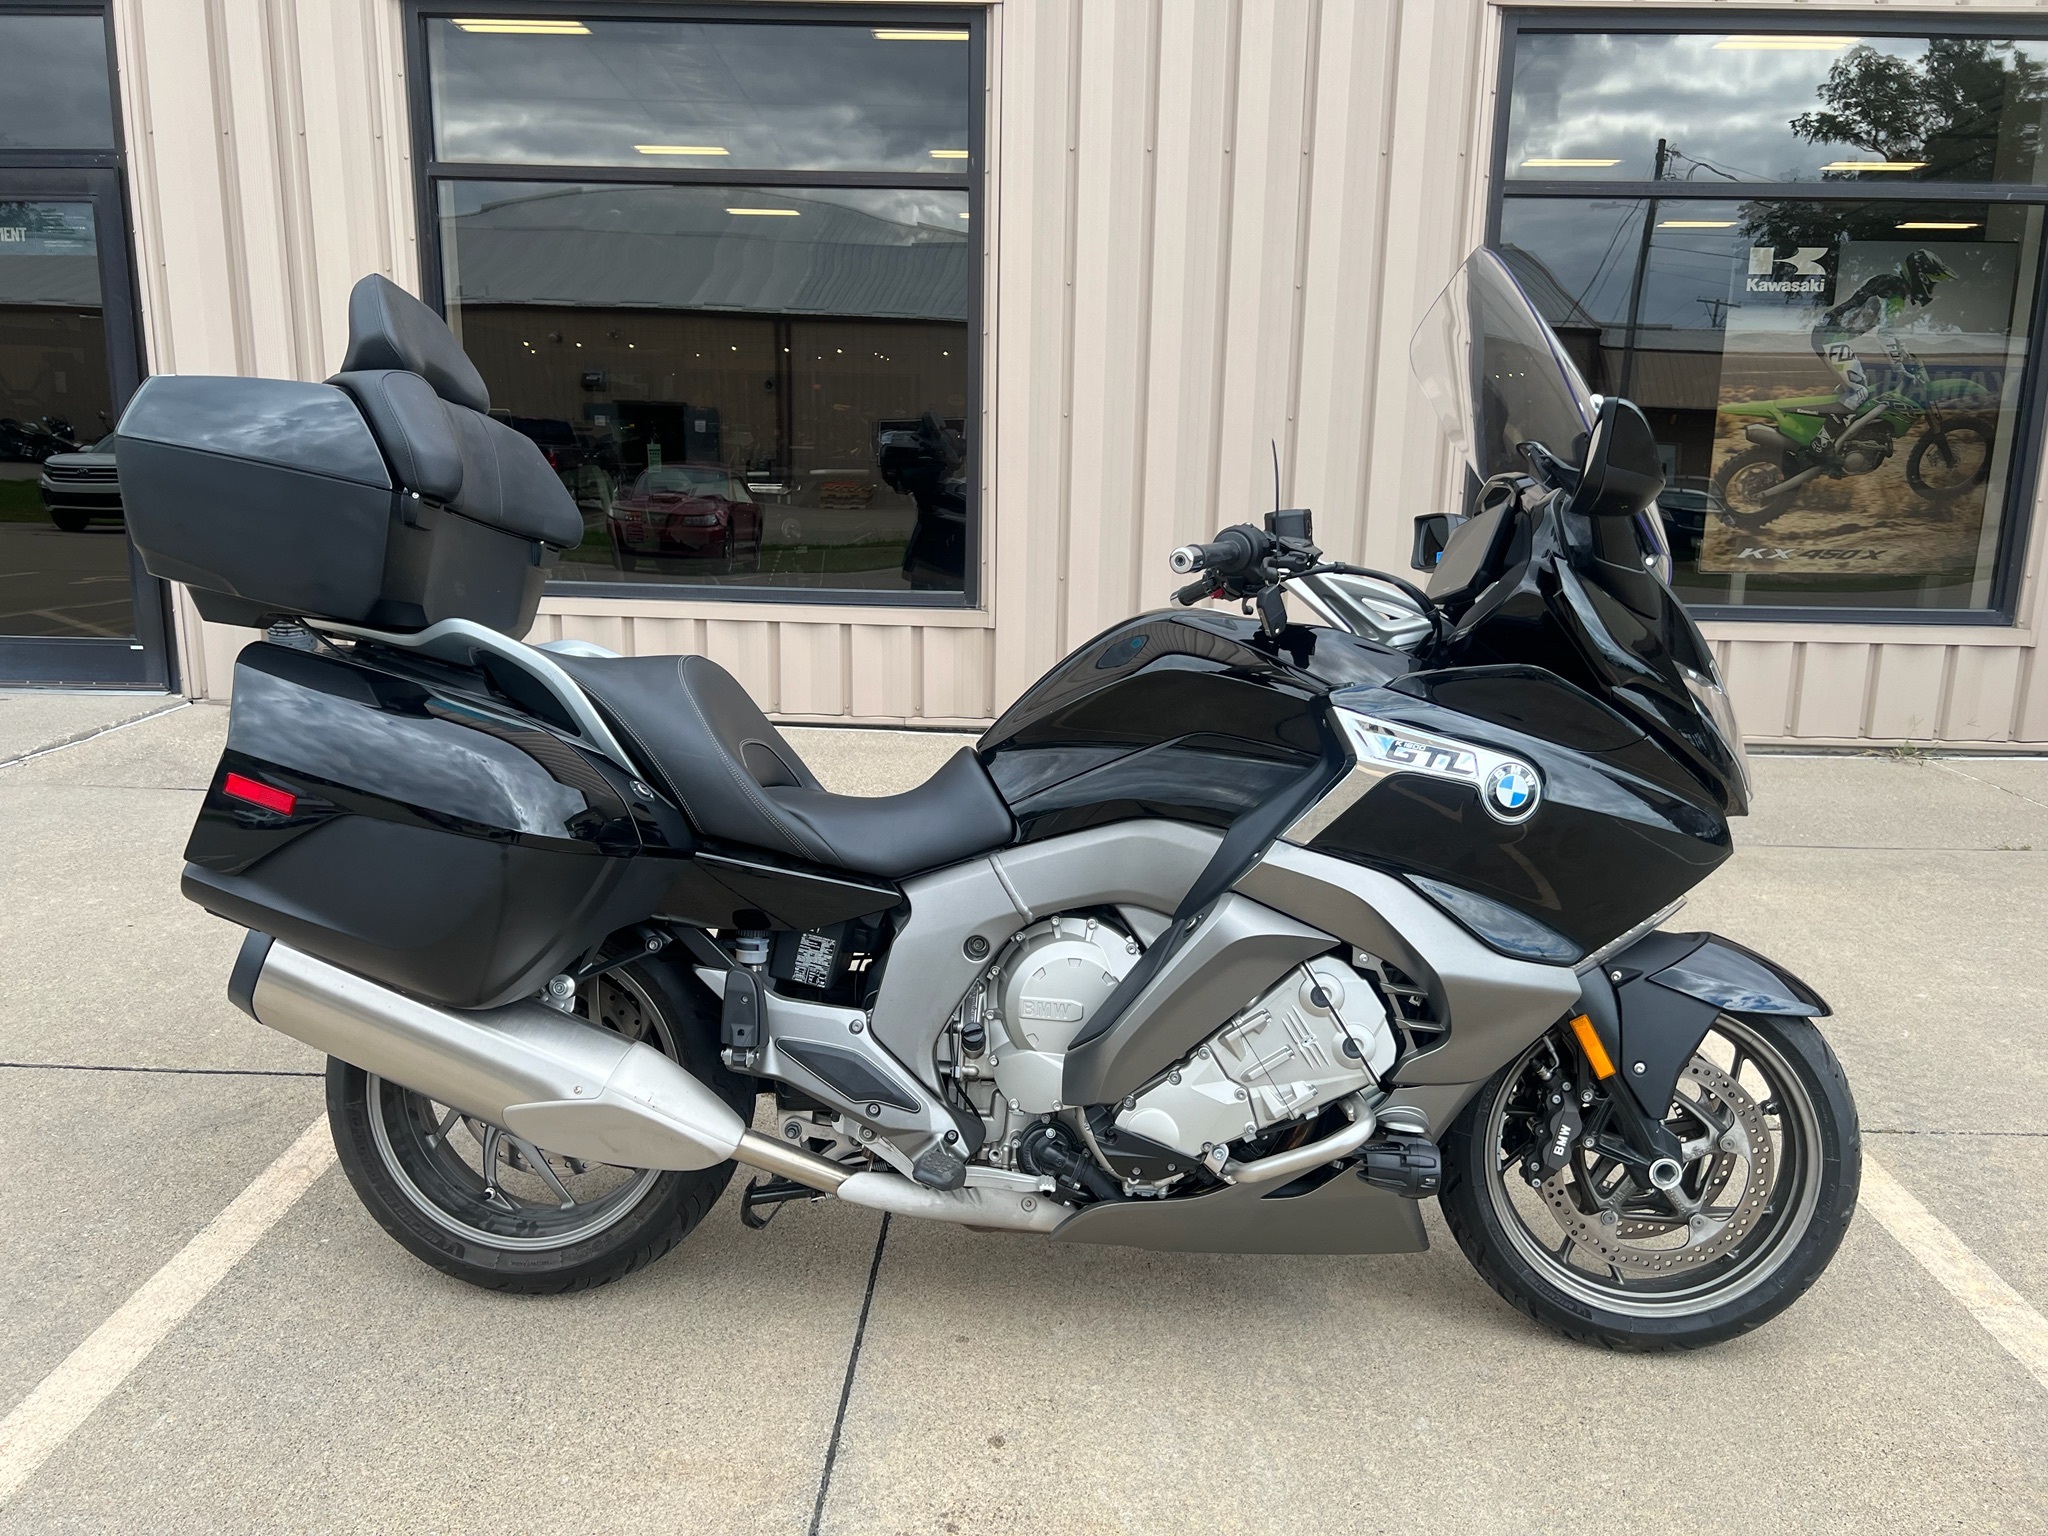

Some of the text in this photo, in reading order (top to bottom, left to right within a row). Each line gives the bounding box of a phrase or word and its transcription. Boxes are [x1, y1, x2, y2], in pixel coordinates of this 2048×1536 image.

[1746, 278, 1826, 292] Kawasaki
[1386, 741, 1474, 775] GTL
[1494, 765, 1536, 787] BMW
[1022, 1000, 1072, 1019] BMW
[1553, 1124, 1571, 1156] BMW
